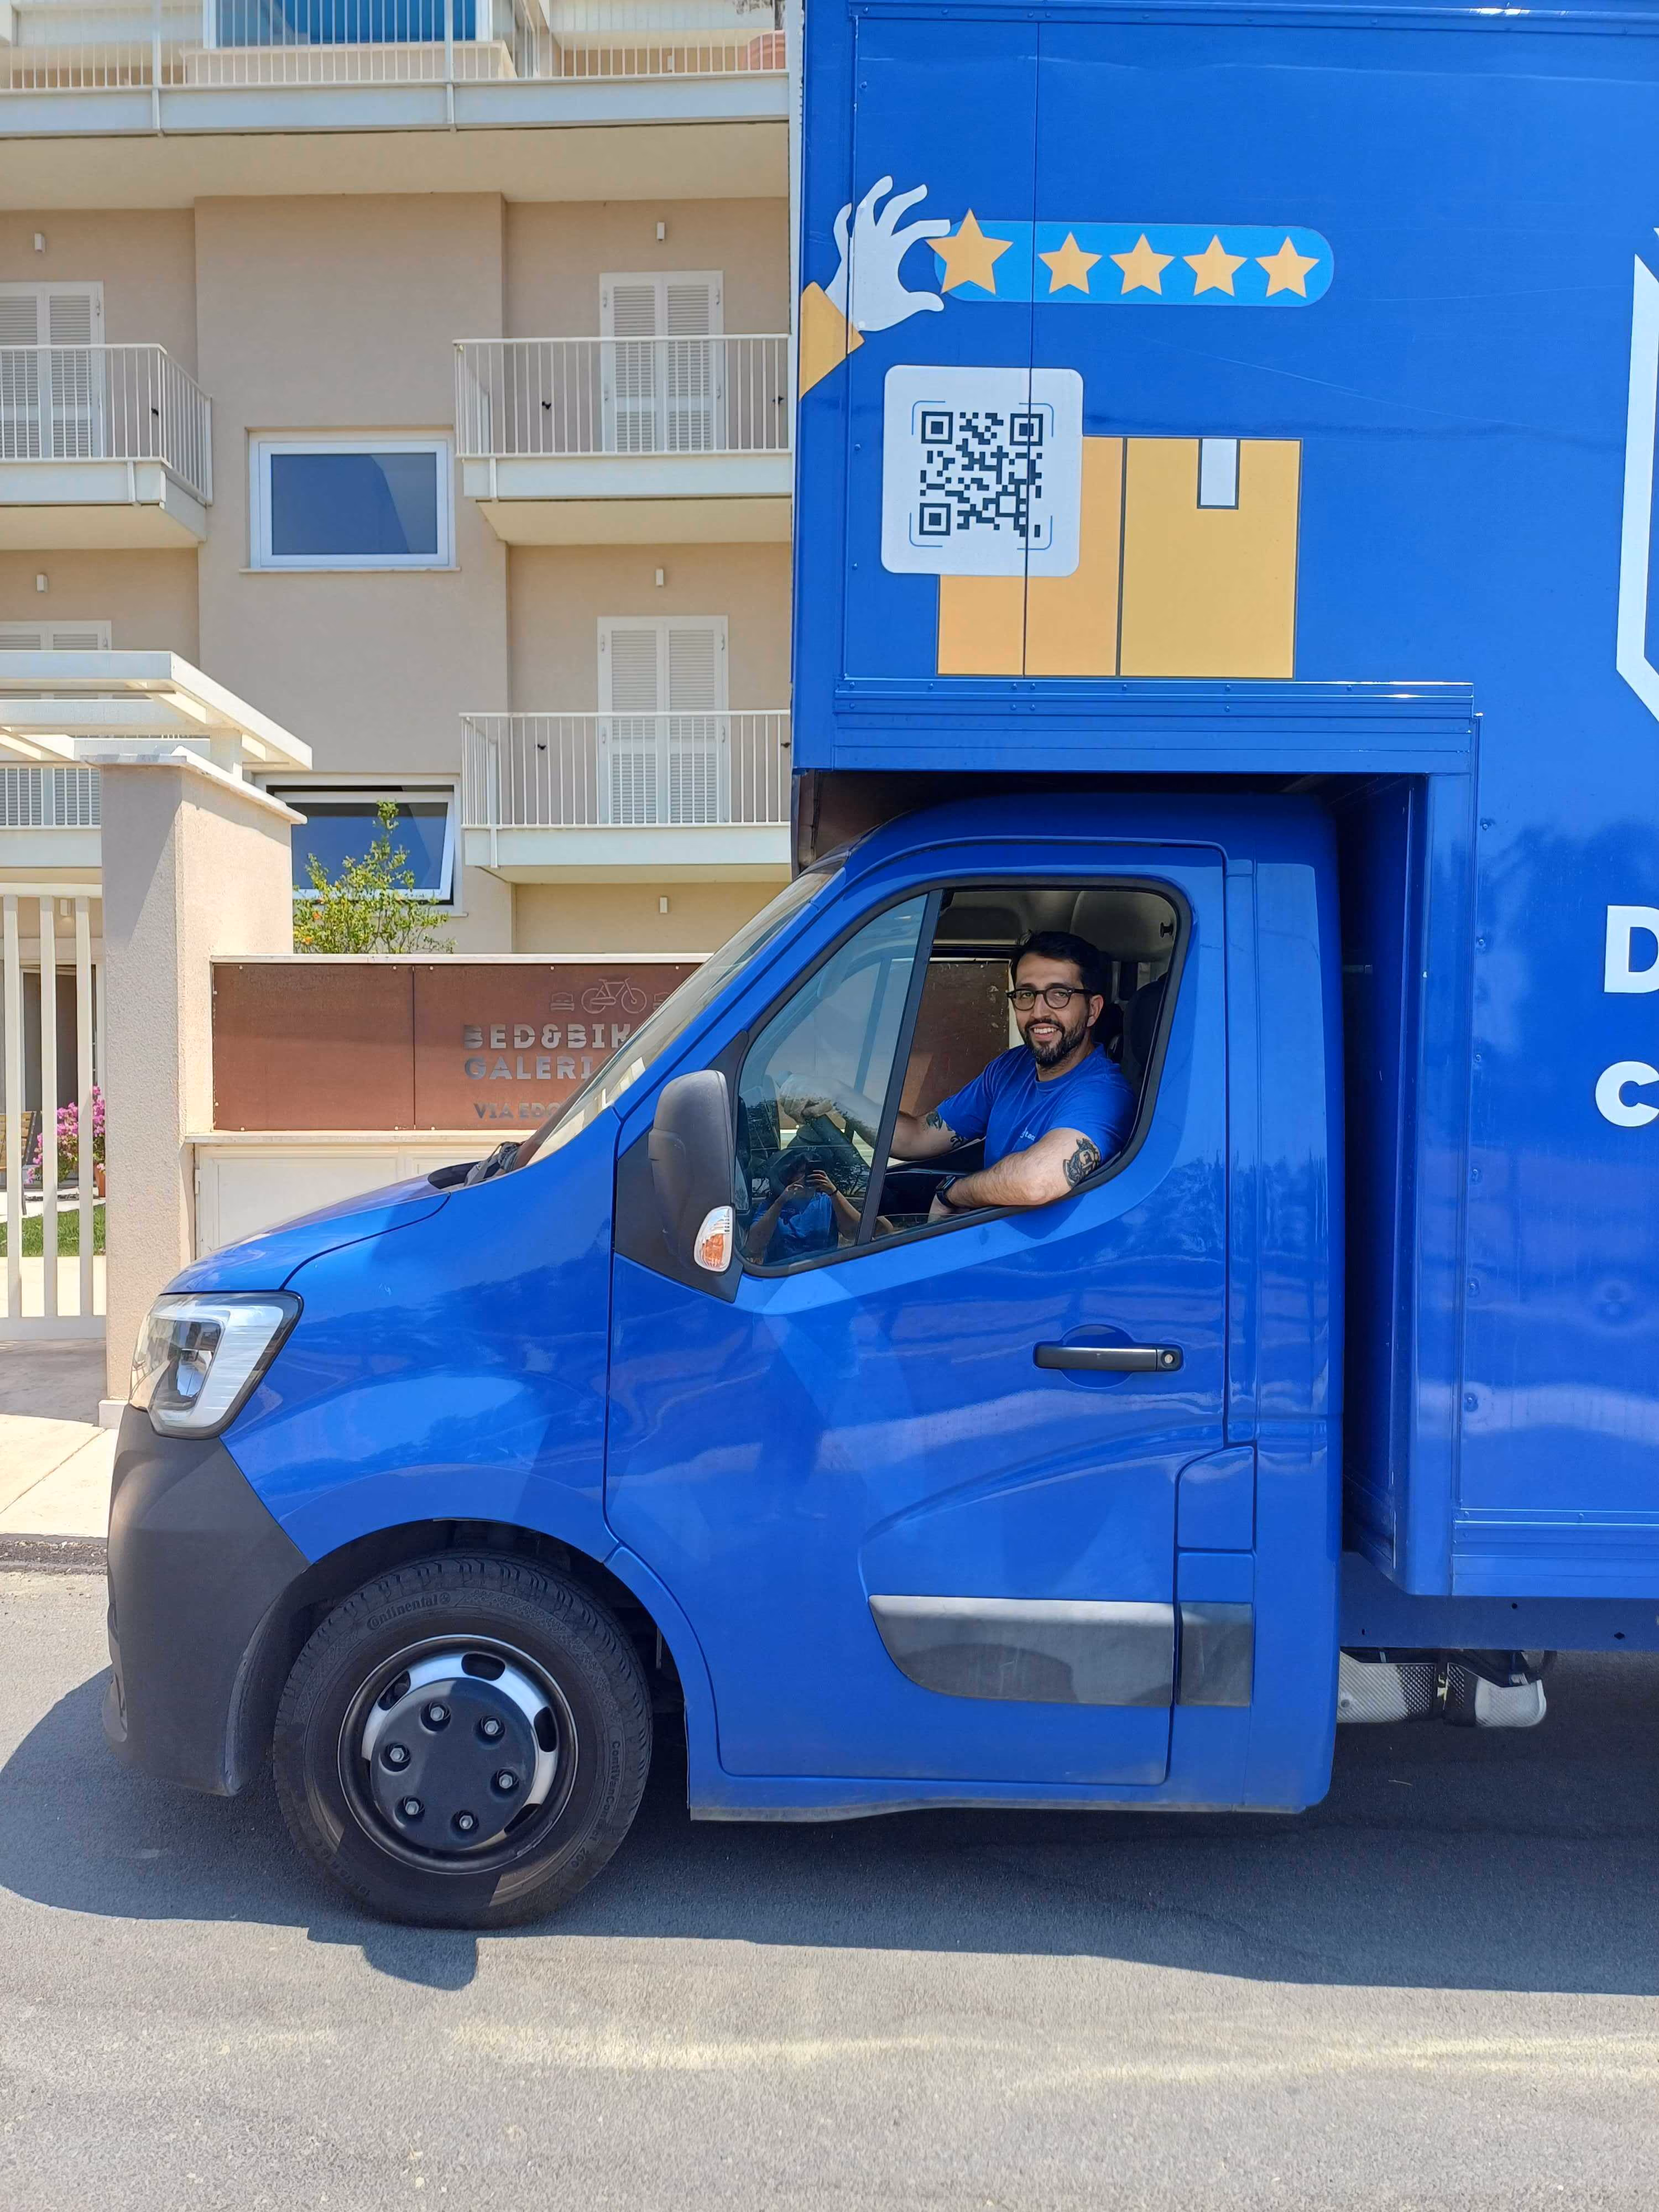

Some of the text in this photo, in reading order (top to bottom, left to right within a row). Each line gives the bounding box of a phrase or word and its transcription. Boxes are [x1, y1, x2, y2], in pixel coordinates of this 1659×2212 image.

[464, 1023, 631, 1049] BED&BIK
[464, 1056, 593, 1080] GALERI
[473, 1103, 514, 1119] VIA
[367, 1593, 439, 1630] Continental
